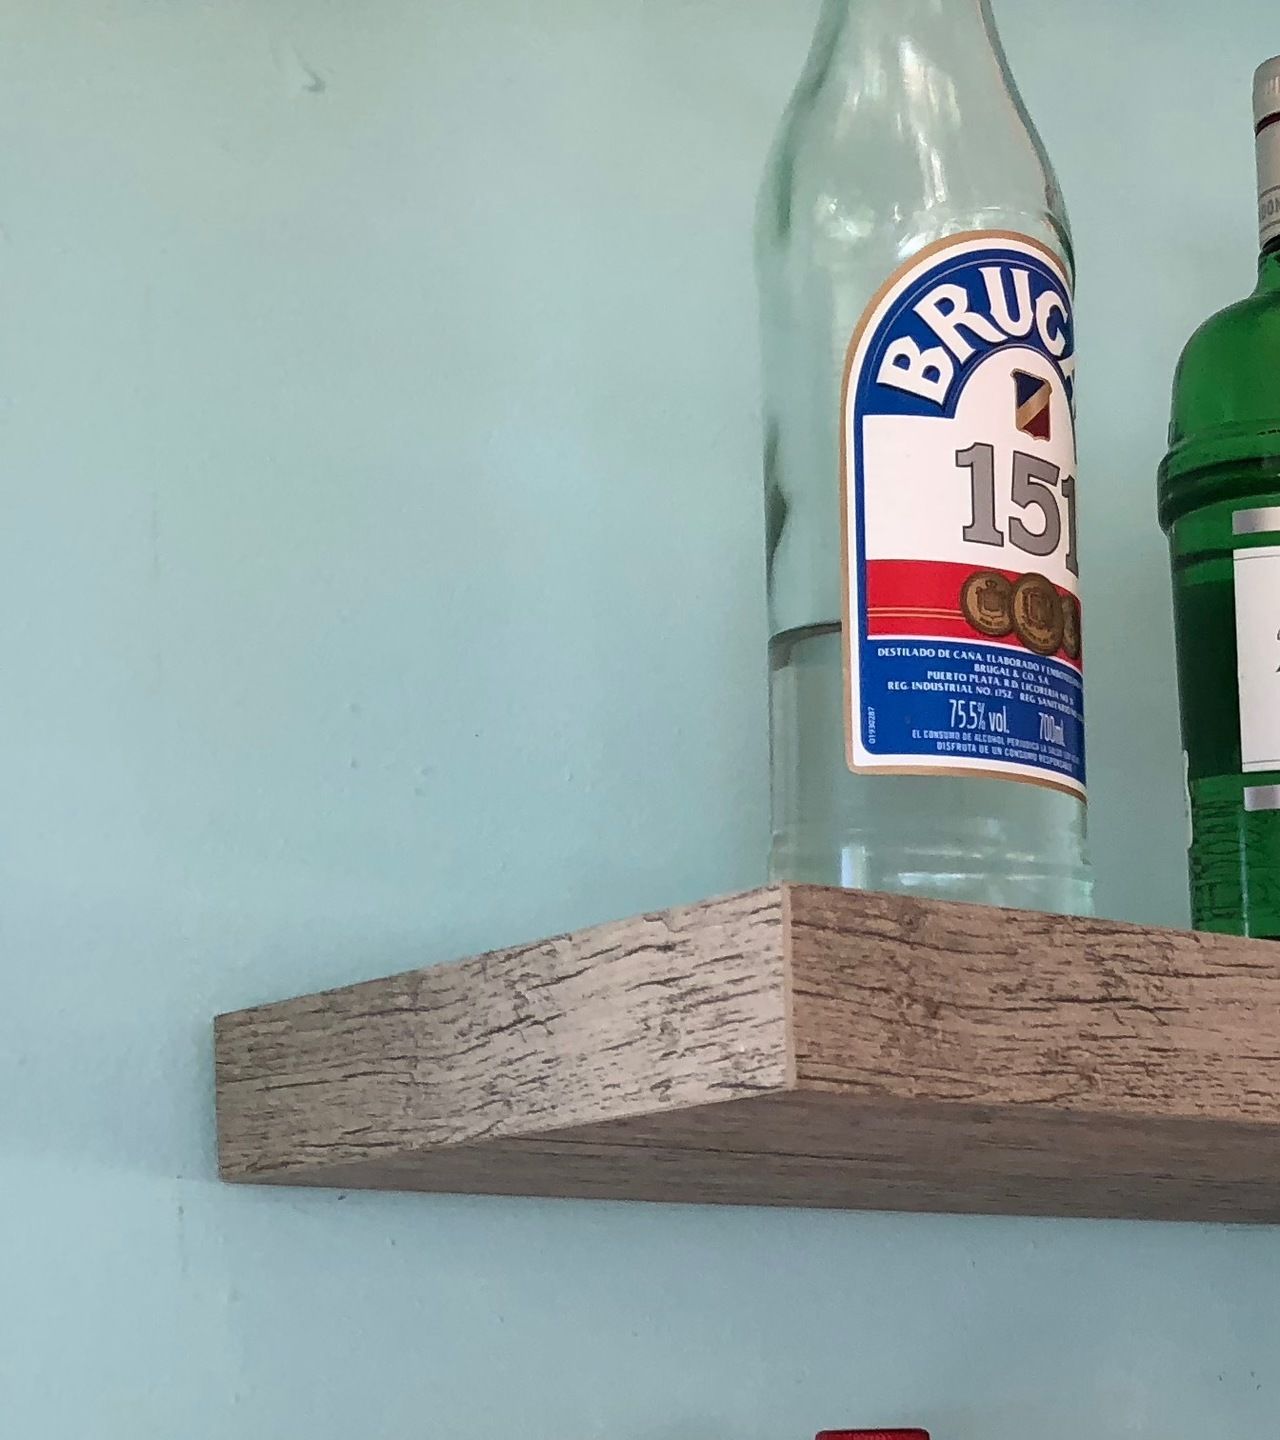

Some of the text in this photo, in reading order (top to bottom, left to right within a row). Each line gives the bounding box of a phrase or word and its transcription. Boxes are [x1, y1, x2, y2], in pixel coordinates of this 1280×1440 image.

[876, 266, 1075, 406] BRUG
[955, 441, 1080, 578] 151
[877, 647, 936, 658] DESTILADO
[937, 648, 951, 660] DE
[927, 670, 968, 682] PUERTO
[974, 663, 1011, 678] BRUGAL
[911, 681, 973, 694] INDUSTRIAL
